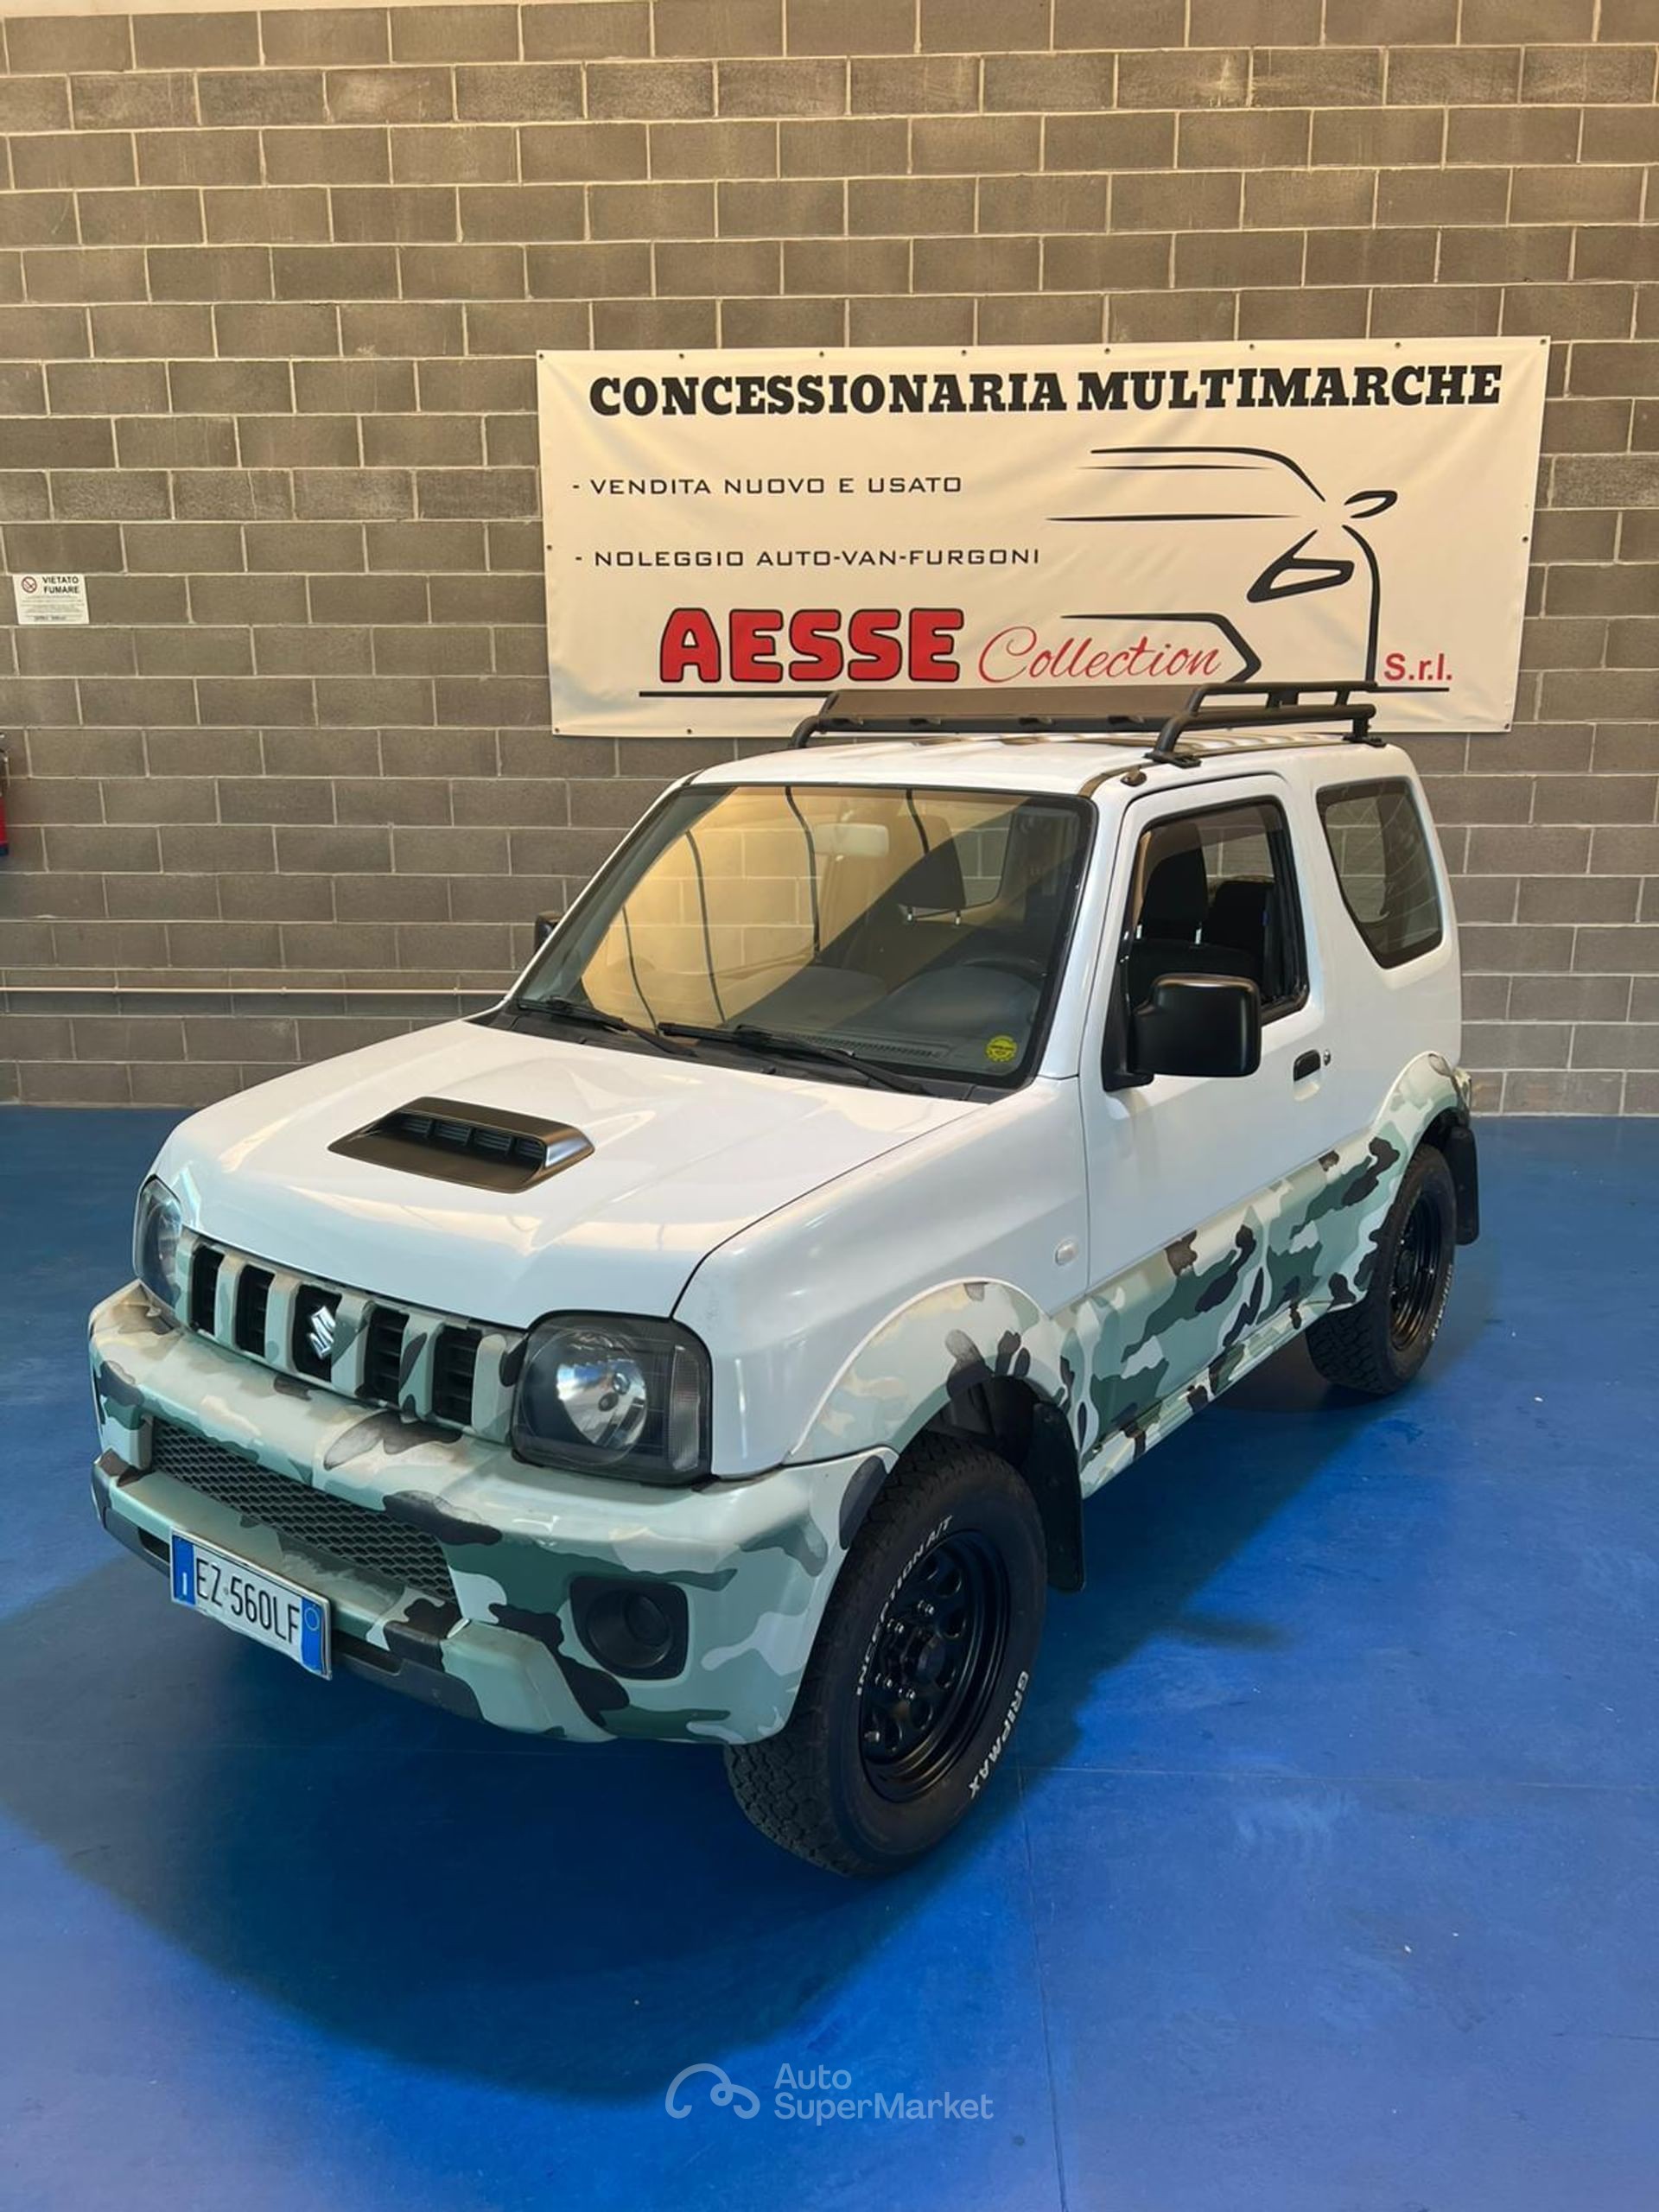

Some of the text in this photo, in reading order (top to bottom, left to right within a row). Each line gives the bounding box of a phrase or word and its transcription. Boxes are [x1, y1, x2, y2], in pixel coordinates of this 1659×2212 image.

[589, 365, 1503, 416] CONCESSIONARIA MULTIMARCHE
[590, 479, 711, 495] VENDITA
[724, 478, 824, 494] NUOVO
[839, 477, 855, 493] E
[868, 476, 962, 493] USATO
[594, 550, 744, 567] NOLEGGIO
[756, 549, 1039, 567] AUTO-VAN-FURGONI
[41, 575, 79, 585] VIETATO
[43, 586, 79, 594] FUMARE
[659, 607, 1453, 683] AESSE Collection S.r.l.
[968, 1670, 1029, 1800] GRIPMAX
